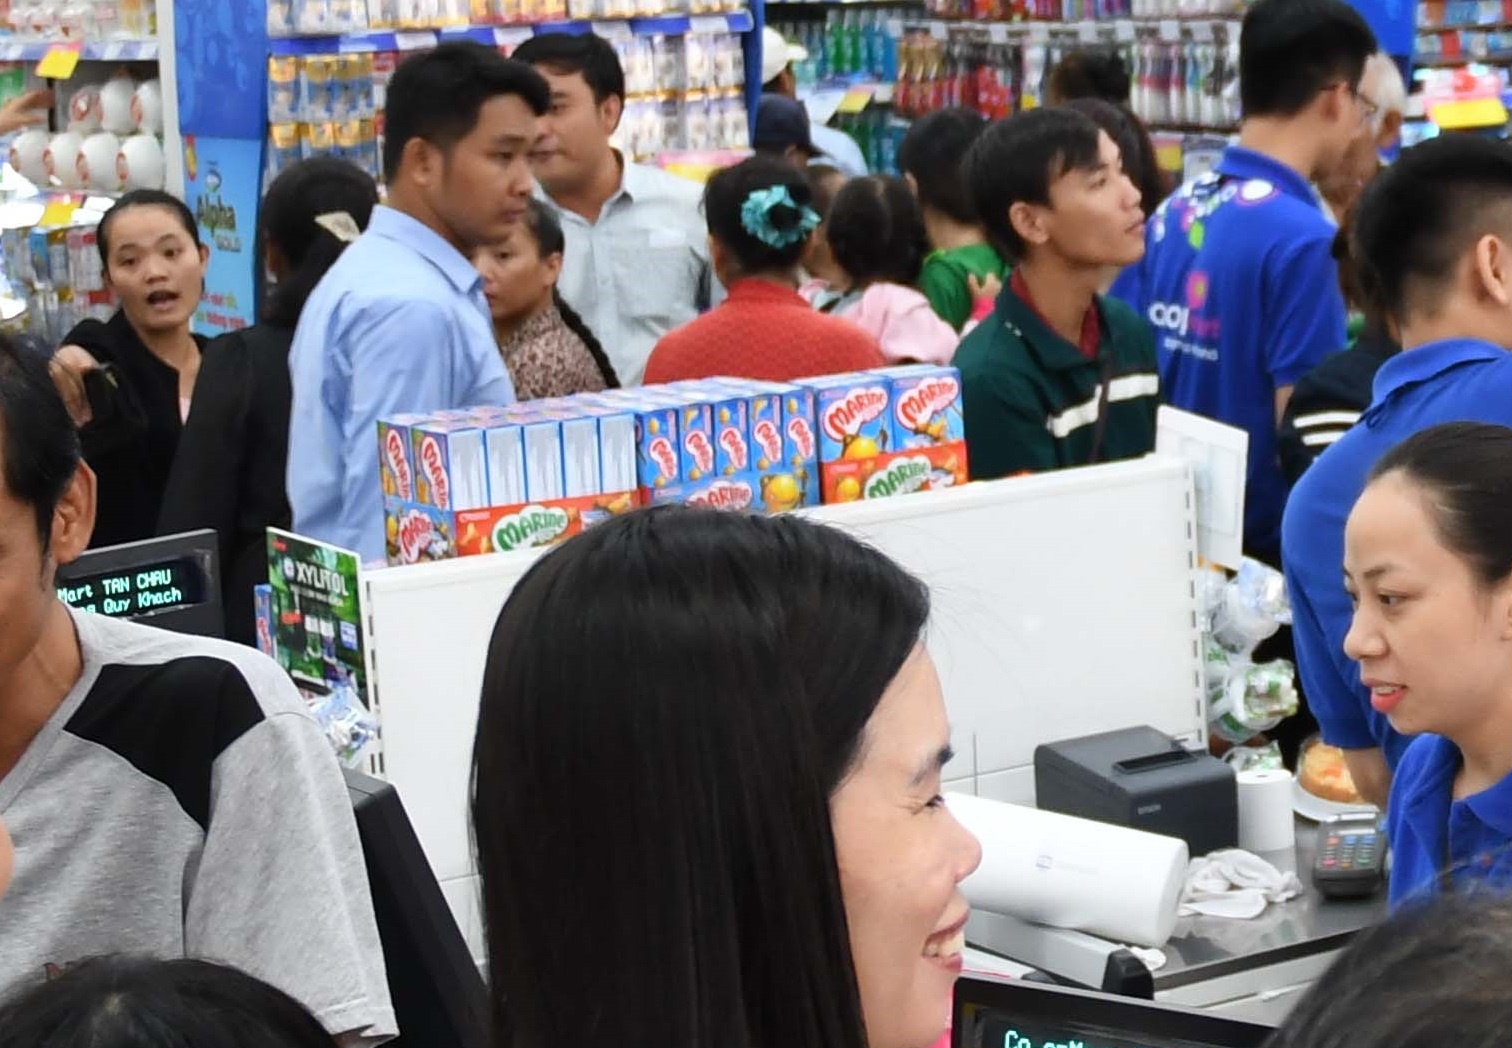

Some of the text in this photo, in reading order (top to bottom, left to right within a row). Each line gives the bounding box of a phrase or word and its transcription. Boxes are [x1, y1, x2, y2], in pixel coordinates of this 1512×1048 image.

[102, 577, 130, 595] TAN
[136, 569, 172, 590] CHAU
[103, 598, 131, 614] Quy
[138, 587, 182, 609] Khach
